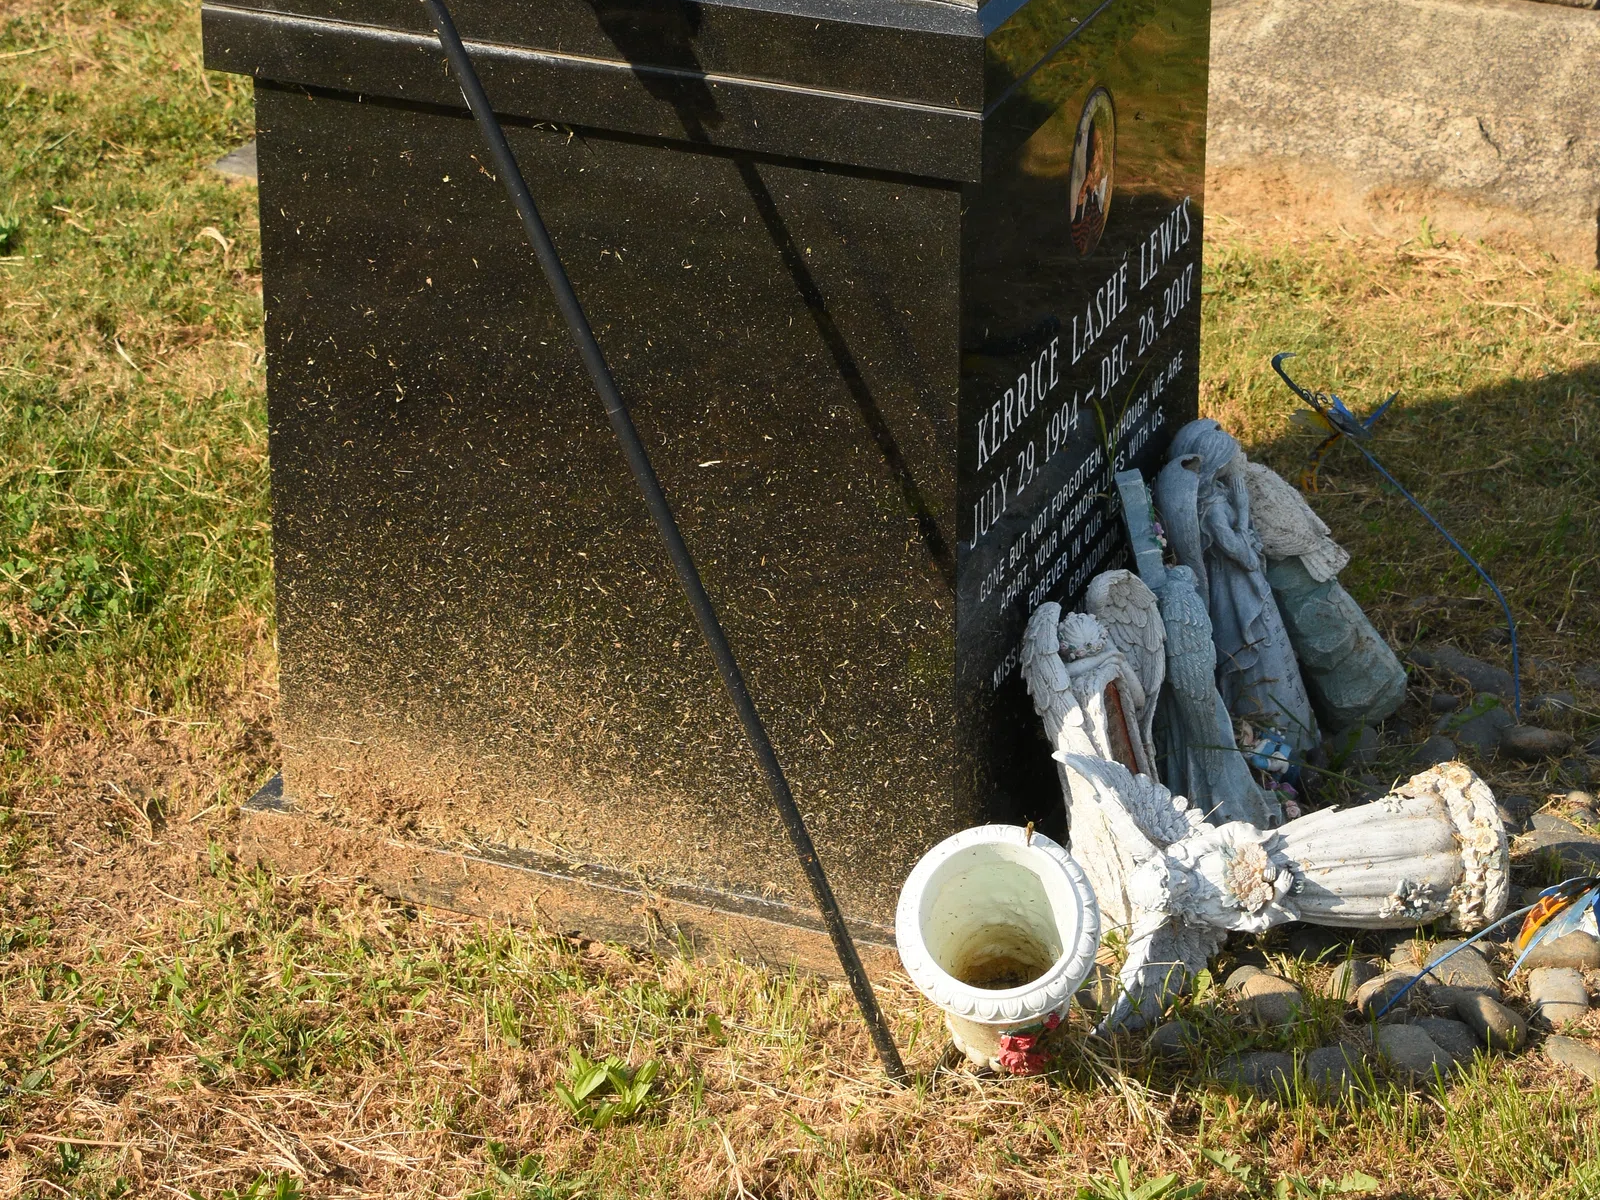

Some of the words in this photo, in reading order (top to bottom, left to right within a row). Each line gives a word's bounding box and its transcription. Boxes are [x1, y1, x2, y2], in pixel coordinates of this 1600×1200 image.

[970, 466, 1010, 550] JULY
[1016, 441, 1039, 496] 29,
[1045, 390, 1079, 463] 1994
[1101, 334, 1133, 400] DEC.
[1162, 262, 1194, 329] 2017
[977, 336, 1059, 471] KERRICE
[1072, 251, 1128, 365] LASHÉ
[1139, 195, 1190, 290] LEWIS
[980, 557, 1005, 603] GONE
[1009, 531, 1027, 569] BUT
[1030, 506, 1048, 544] NOT
[1151, 371, 1164, 400] WE
[1166, 350, 1183, 384] ARE
[999, 563, 1030, 615] APART,
[1034, 530, 1058, 572] YOUR
[1061, 479, 1099, 540] MEMORY
[1128, 421, 1149, 459] WITH
[1028, 551, 1068, 614] FOREVER
[1071, 534, 1081, 561] IN
[1084, 510, 1102, 545] OUR
